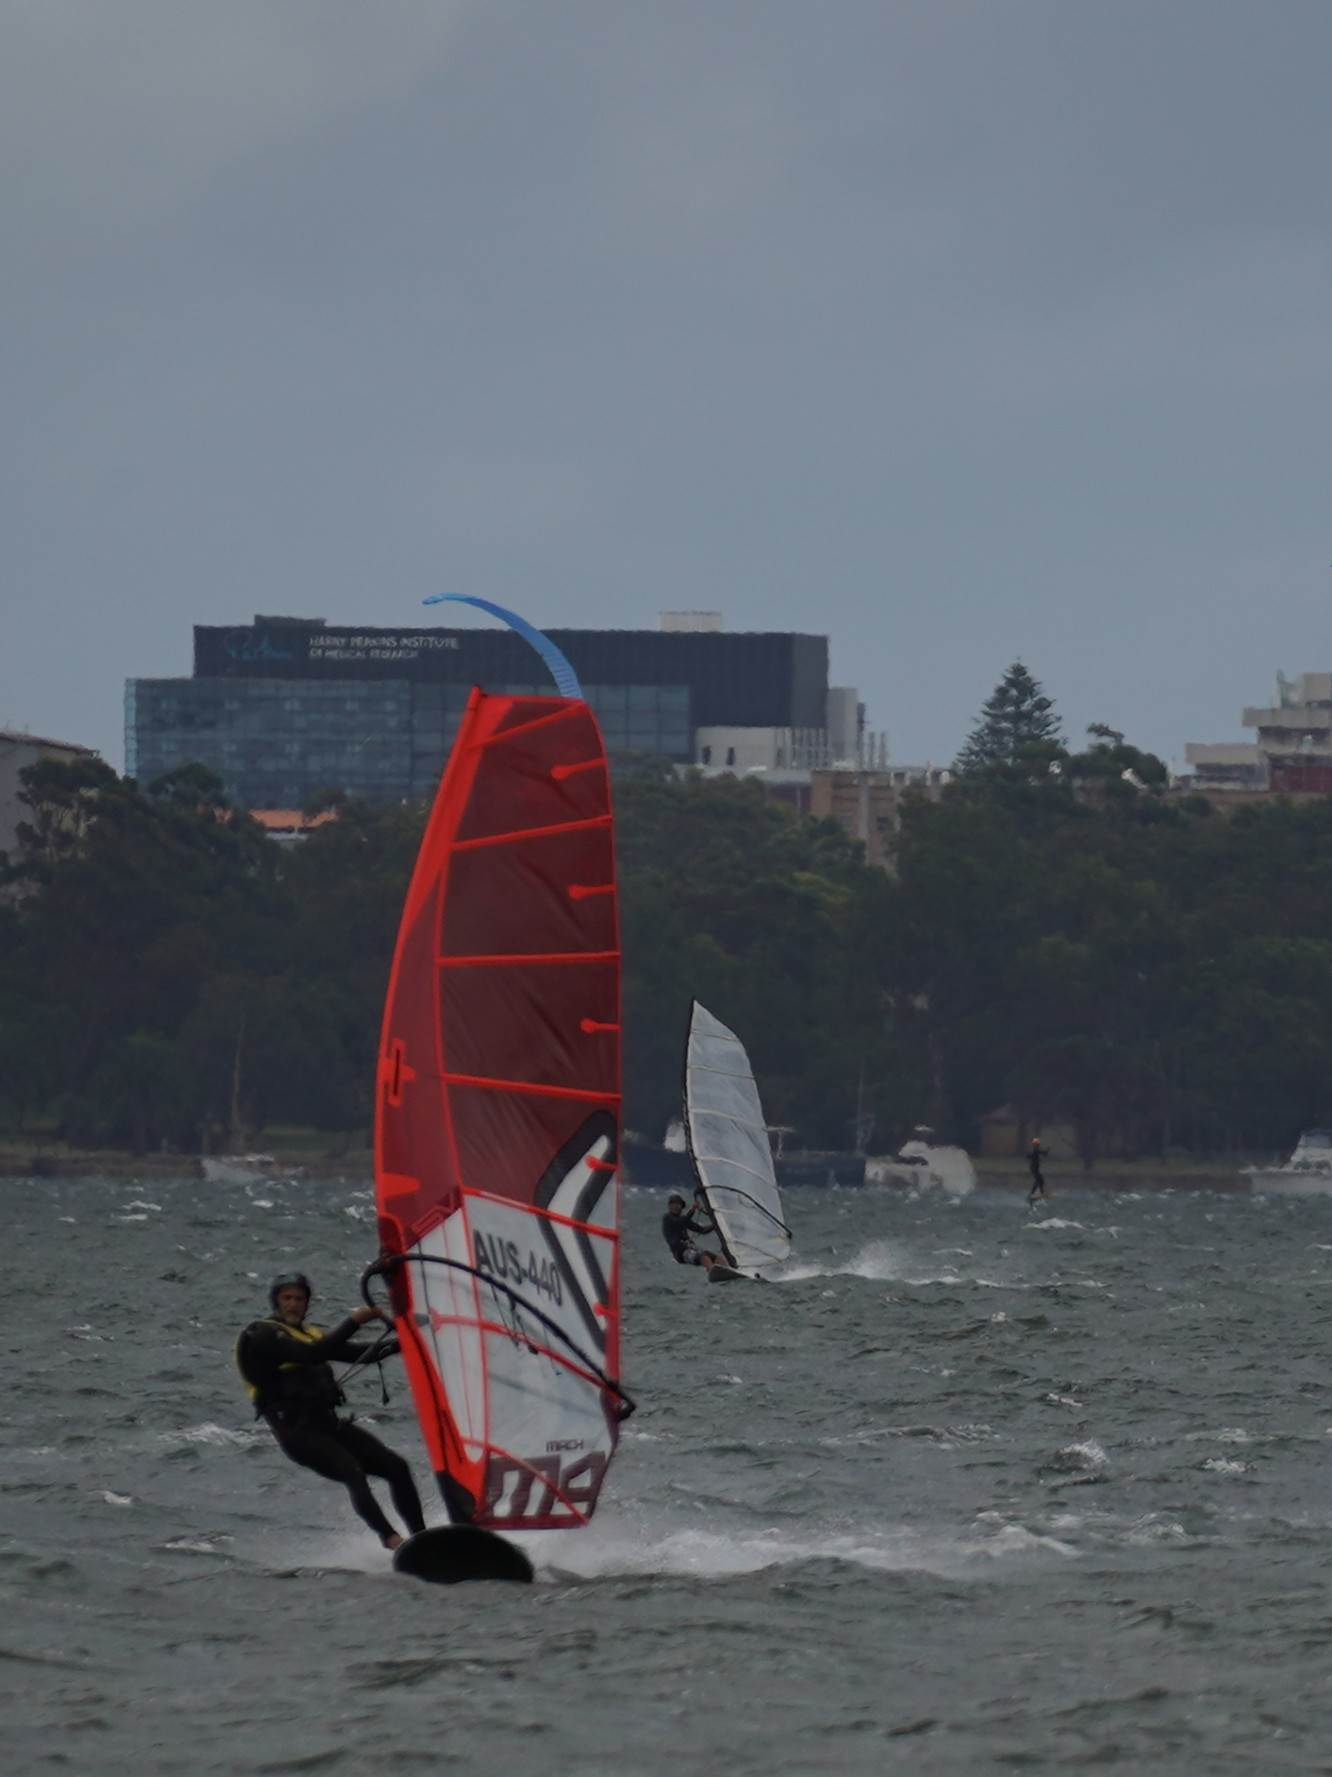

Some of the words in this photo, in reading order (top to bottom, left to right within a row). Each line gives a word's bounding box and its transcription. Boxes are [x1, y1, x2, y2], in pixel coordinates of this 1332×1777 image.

[309, 637, 346, 648] HARRY
[351, 637, 397, 648] PERKINS
[400, 637, 459, 649] INSTITUTE
[309, 648, 322, 658] OF
[325, 649, 366, 659] MEDICAL
[370, 649, 418, 659] RESEARCH
